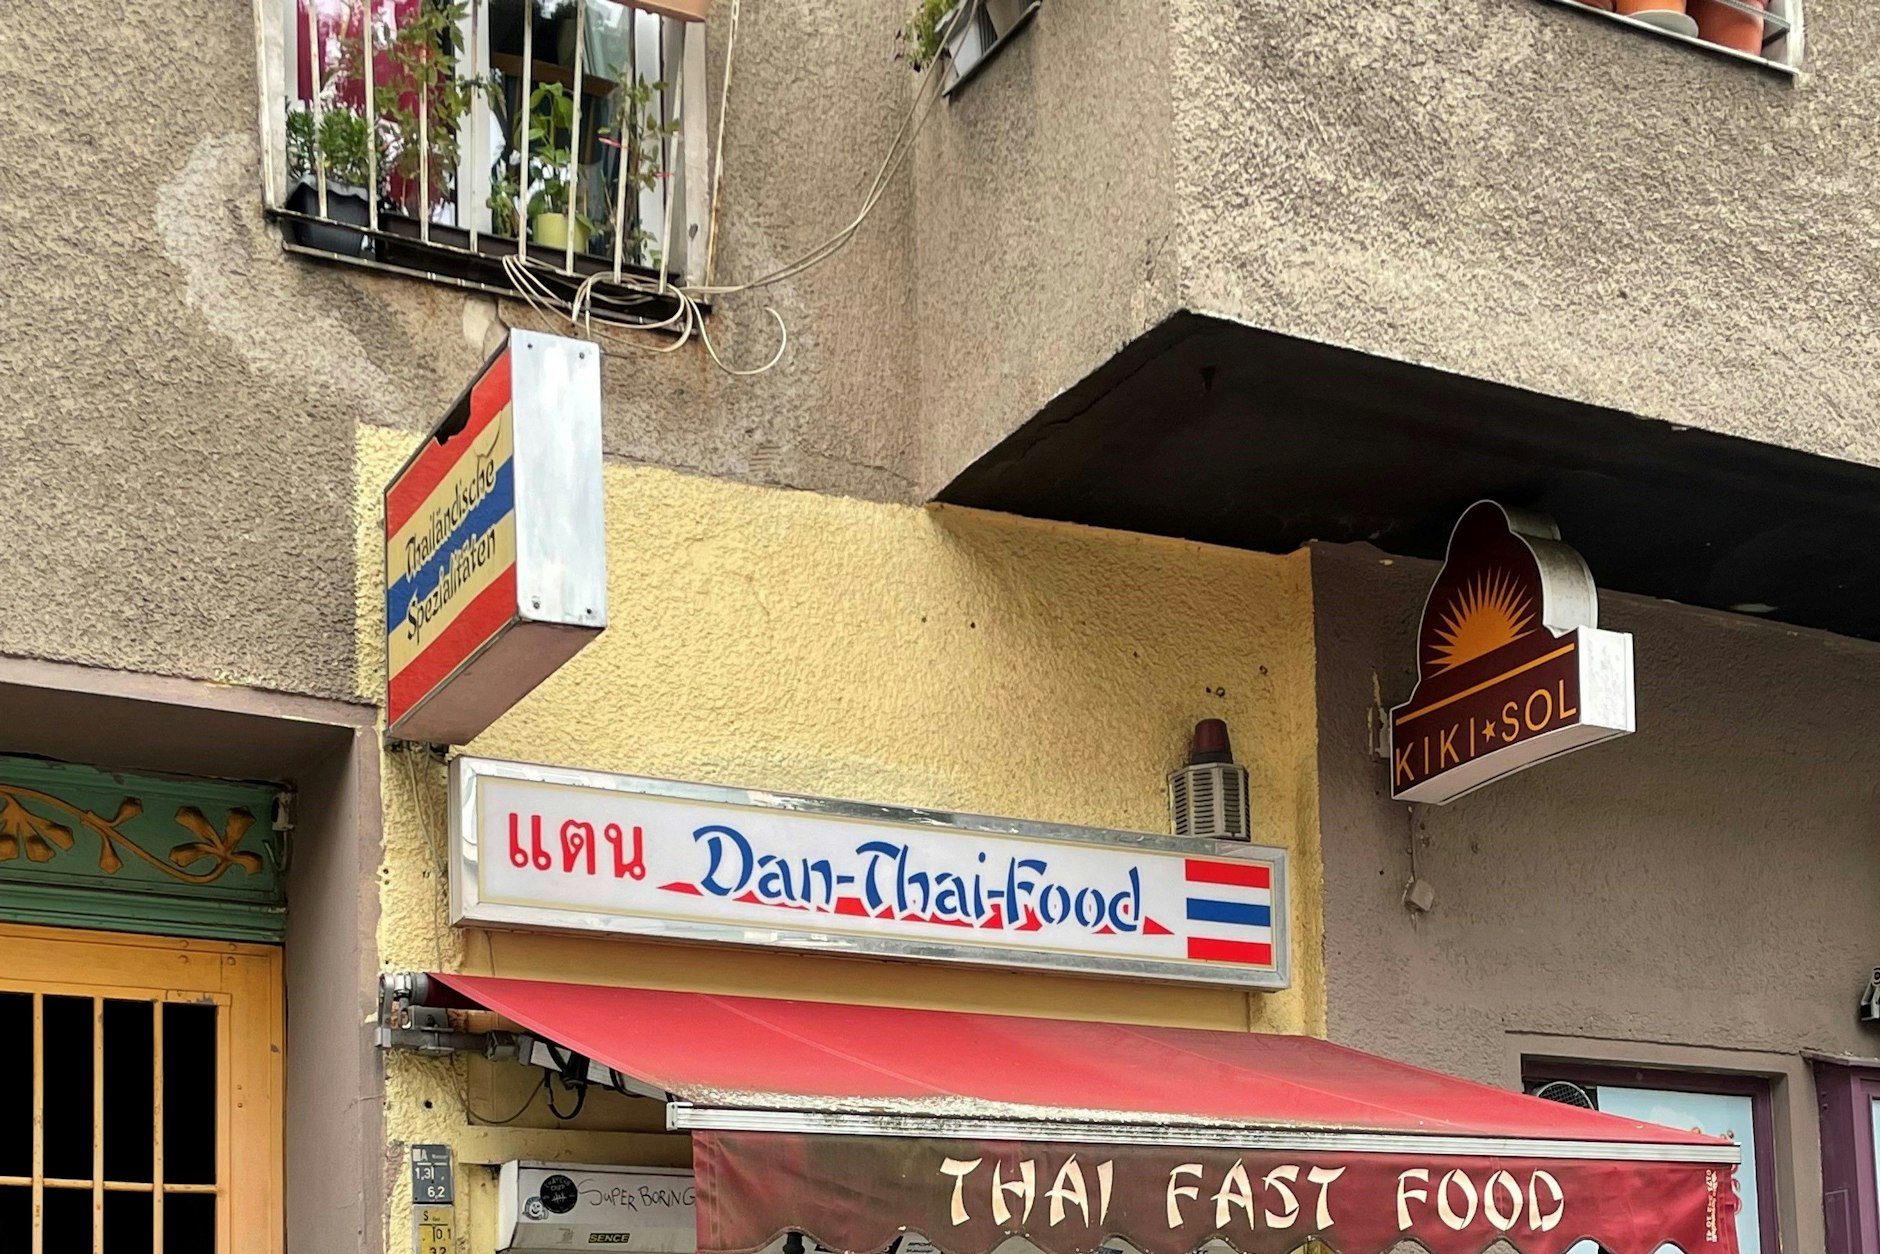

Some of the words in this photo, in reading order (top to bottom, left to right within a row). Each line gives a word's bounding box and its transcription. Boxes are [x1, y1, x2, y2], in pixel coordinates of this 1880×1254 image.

[404, 455, 496, 582] Thailändische
[405, 528, 497, 645] Spezialitäten
[1396, 718, 1476, 786] KIKI
[1501, 679, 1577, 742] SOL
[509, 812, 646, 880] แตน
[692, 824, 1142, 934] Dan-Thai-Food
[589, 1233, 630, 1243] SENCE
[940, 1152, 1114, 1228] THAI
[1165, 1157, 1347, 1231] FAST
[1397, 1167, 1565, 1232] FOOD
